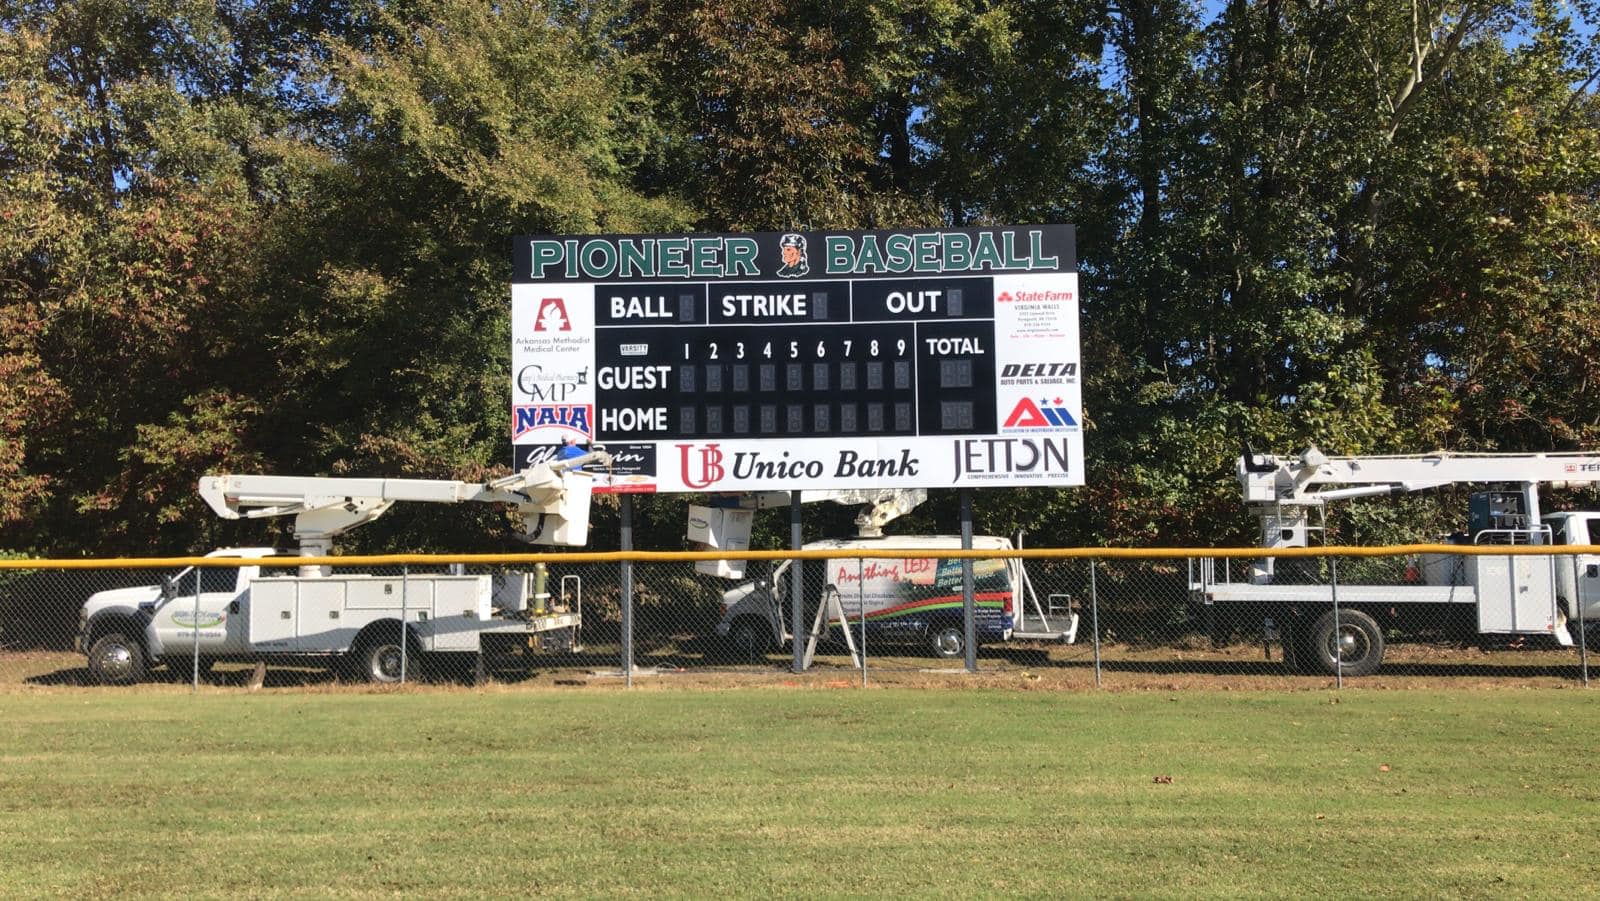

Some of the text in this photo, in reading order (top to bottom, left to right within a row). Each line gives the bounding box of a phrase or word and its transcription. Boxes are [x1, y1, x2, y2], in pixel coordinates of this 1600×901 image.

[530, 230, 1059, 279] PIONEER BASEBALL
[610, 296, 673, 319] BALL
[721, 294, 807, 318] STRIKE
[886, 290, 943, 314] OUT
[515, 336, 591, 345] Arkansas Methodist
[523, 345, 580, 353] Medical Center
[684, 339, 906, 360] 1 2 3 4 5 6 7 8 9
[926, 337, 985, 355] TOTAL
[597, 365, 672, 390] GUEST
[1001, 363, 1077, 378] DELTA
[516, 407, 591, 434] NAIA
[601, 407, 668, 432] HOME
[732, 451, 824, 480] Unico
[834, 448, 920, 478] Bank
[953, 437, 1069, 484] JETTON
